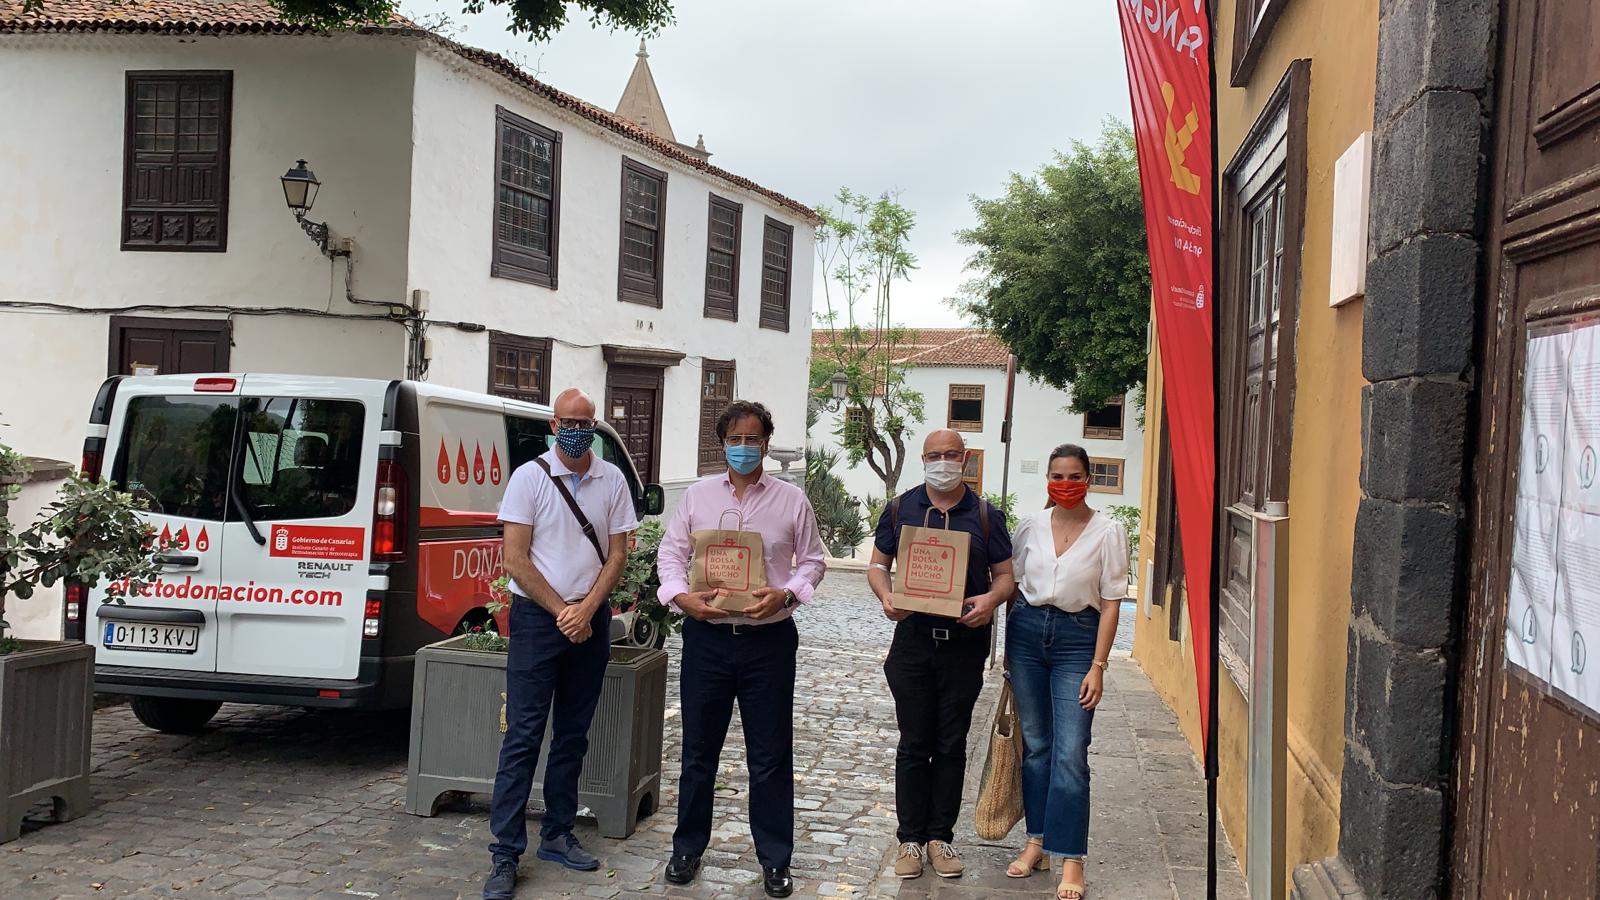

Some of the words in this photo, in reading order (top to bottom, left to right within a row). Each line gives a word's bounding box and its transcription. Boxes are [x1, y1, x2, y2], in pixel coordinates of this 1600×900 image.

[291, 536, 319, 544] Gobierno
[912, 556, 938, 564] BOLSA
[297, 561, 353, 571] RENAULT
[923, 564, 945, 572] PARA
[297, 571, 331, 579] TECH
[910, 571, 942, 580] MUCHO
[110, 575, 343, 606] efctodonacion.com
[116, 626, 159, 644] 0113
[163, 628, 196, 647] KVJ
